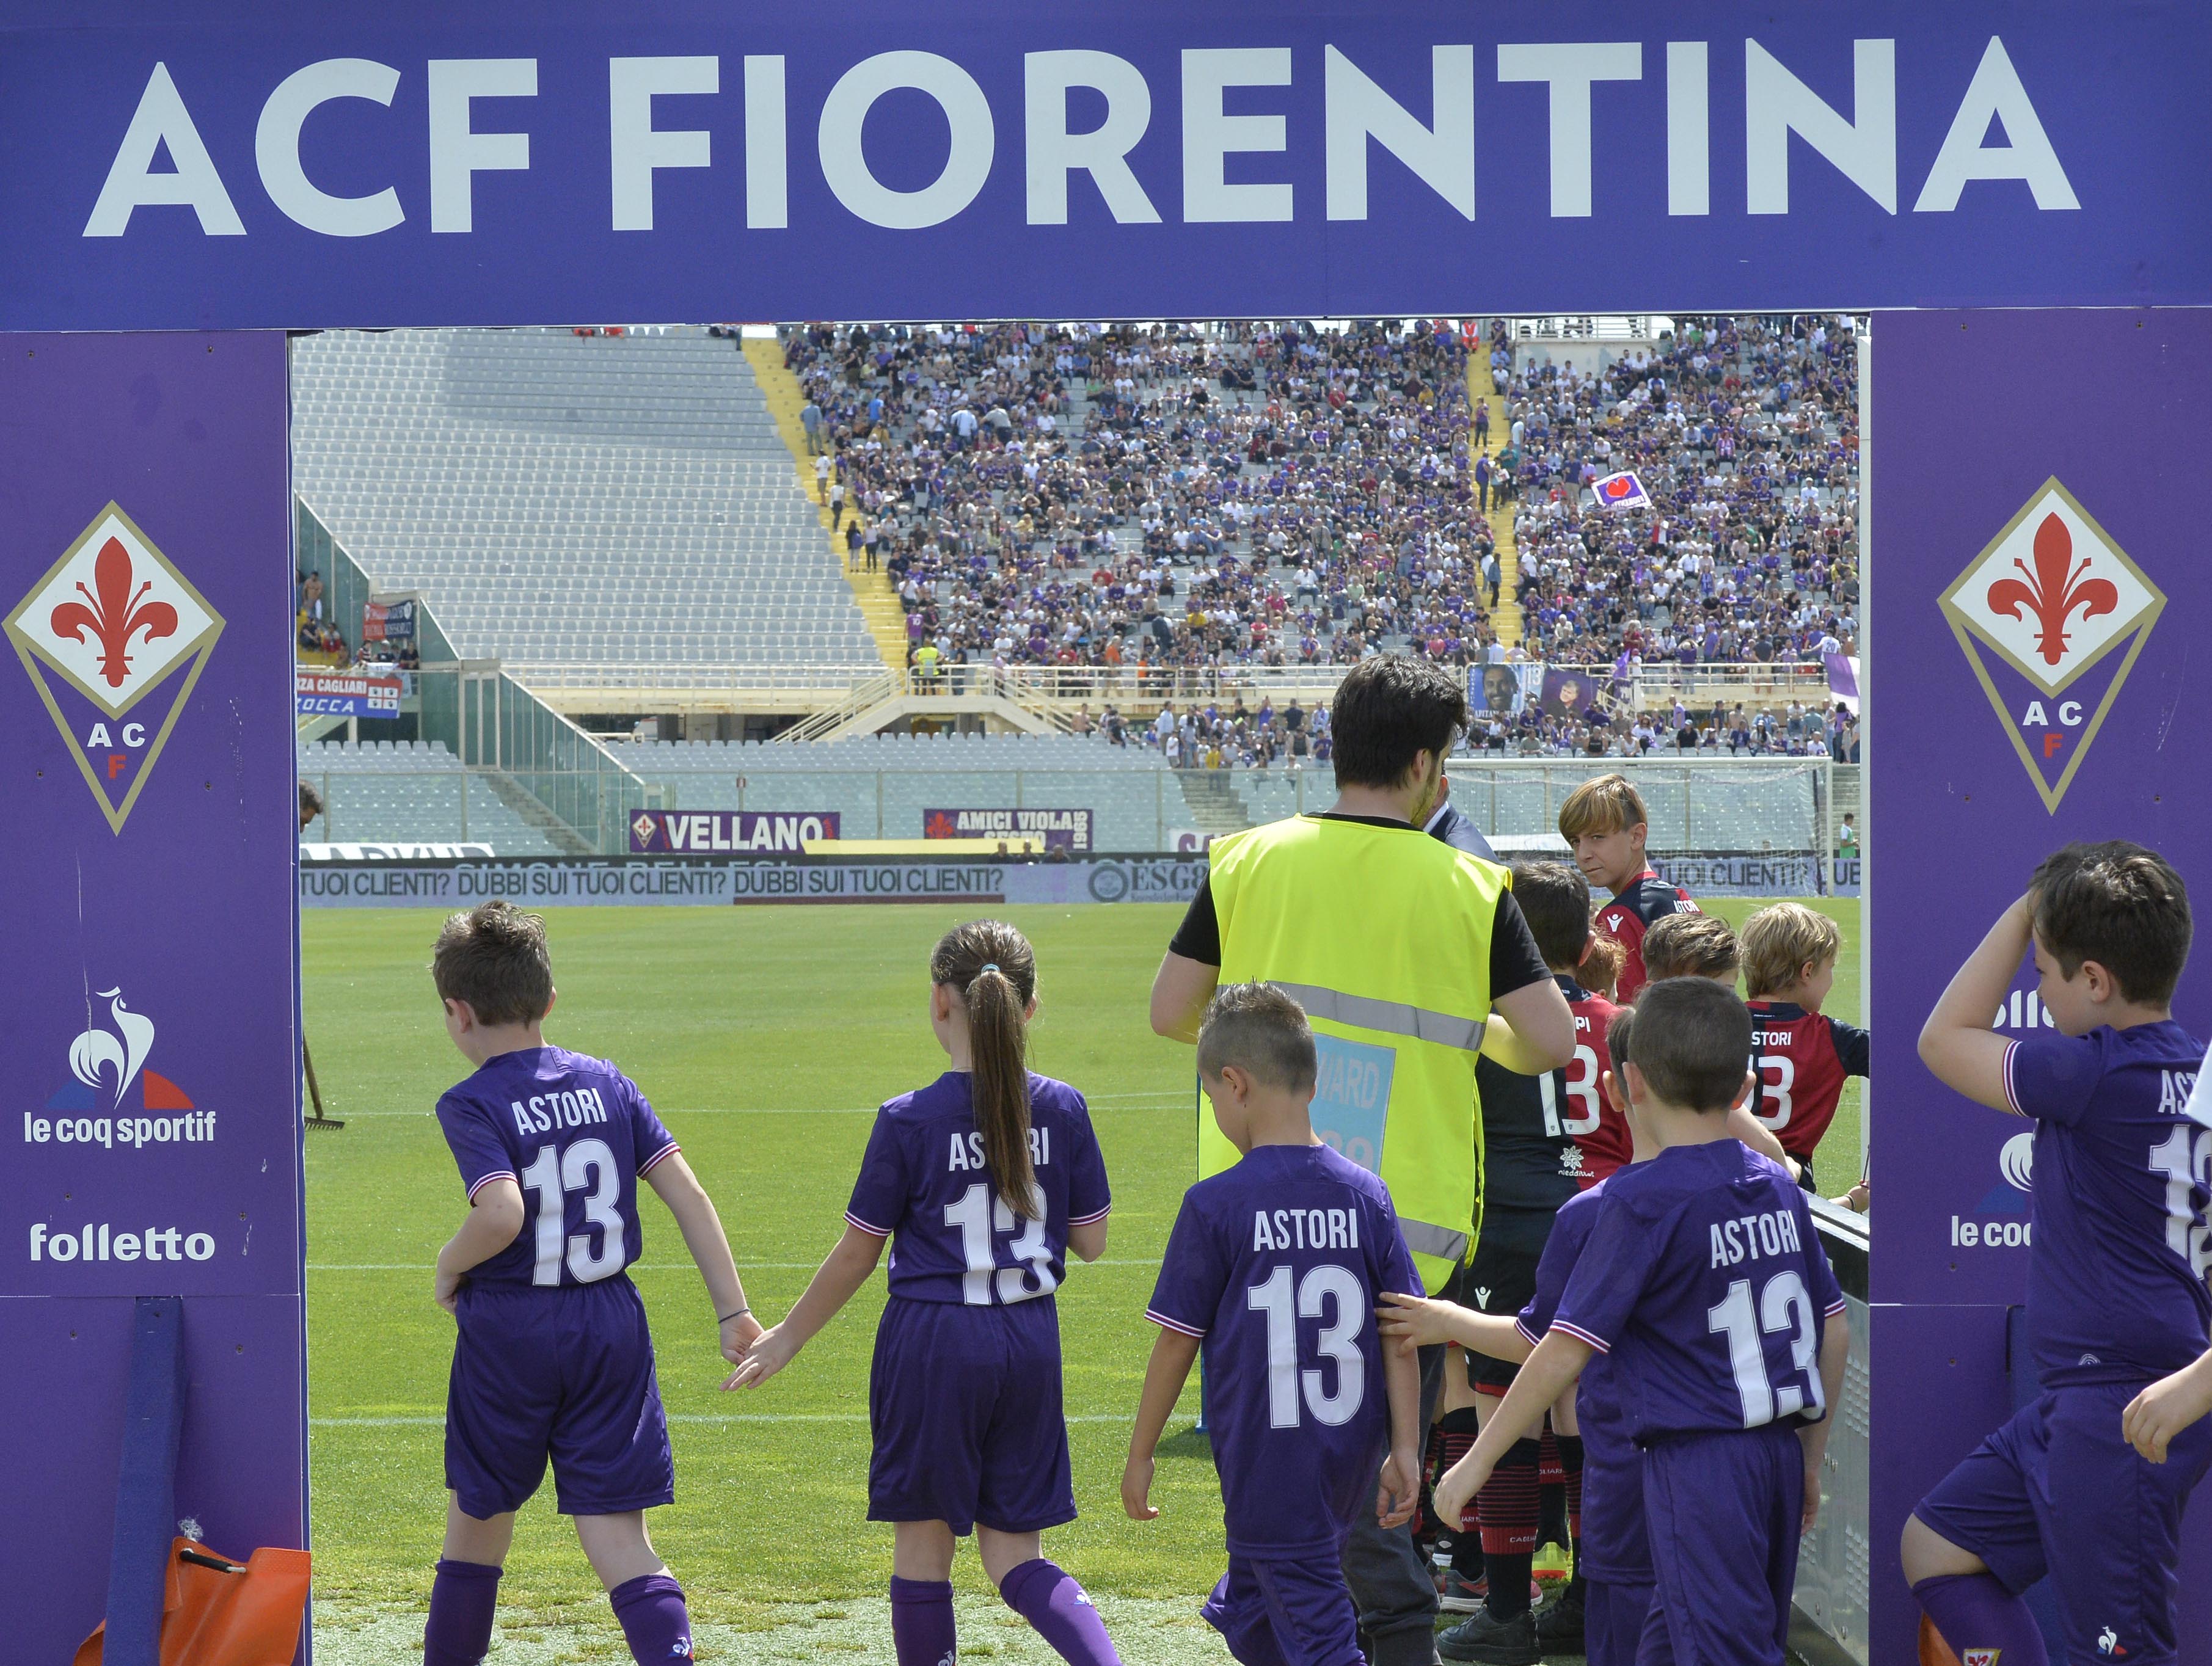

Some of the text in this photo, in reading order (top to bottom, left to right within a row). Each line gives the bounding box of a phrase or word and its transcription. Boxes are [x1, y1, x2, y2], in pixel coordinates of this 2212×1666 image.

[82, 36, 2081, 236] ACF FIORENTINA
[316, 678, 367, 694] CAGLIARI
[665, 815, 823, 851] VELLANO
[957, 811, 1073, 830] AMICI VIOLA
[354, 872, 451, 895] CLIENTI?
[458, 871, 527, 896] DUBBI
[532, 871, 567, 895] SUI
[572, 871, 624, 895] TUOI
[629, 870, 726, 895] CLIENTI?
[734, 869, 803, 893] DUBBI
[808, 869, 844, 893] SUI
[849, 868, 901, 892] TUOI
[907, 867, 1003, 892] CLIENTI?
[511, 1088, 607, 1136] ASTORI
[1539, 1044, 1601, 1137] 13
[24, 1111, 216, 1149] le coq sportif
[949, 1127, 1049, 1171] ASRI
[521, 1138, 626, 1287] 13
[1254, 1208, 1359, 1253] ASTORI
[1951, 1215, 1979, 1247] le
[30, 1223, 216, 1261] folletto
[944, 1183, 1058, 1306] 13
[1710, 1209, 1801, 1270] ASTORI
[1248, 1264, 1365, 1429] 13
[1708, 1270, 1827, 1430] 13
